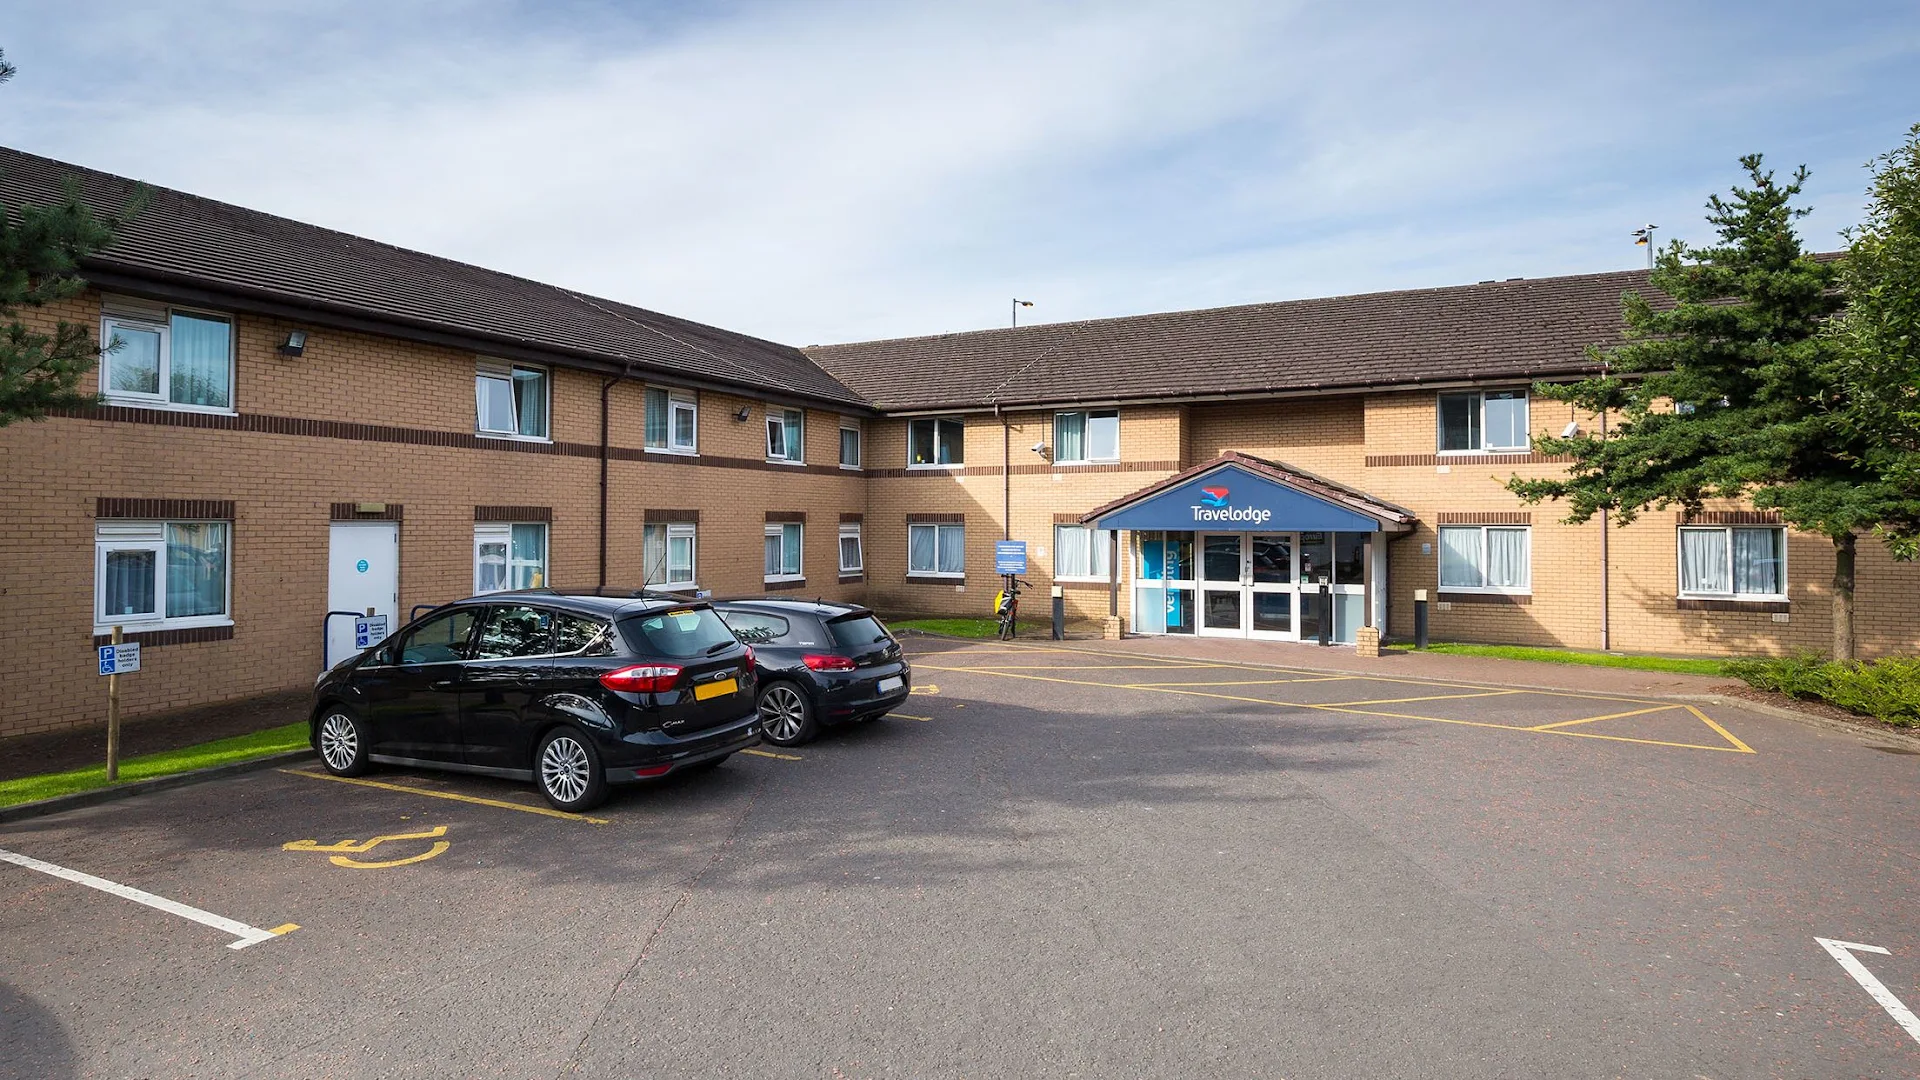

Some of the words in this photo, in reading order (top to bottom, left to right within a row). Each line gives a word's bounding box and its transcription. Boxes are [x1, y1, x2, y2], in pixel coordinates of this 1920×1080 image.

[1190, 505, 1271, 524] Travelodge
[1162, 550, 1177, 613] veing
[359, 624, 366, 633] P
[104, 648, 112, 658] P
